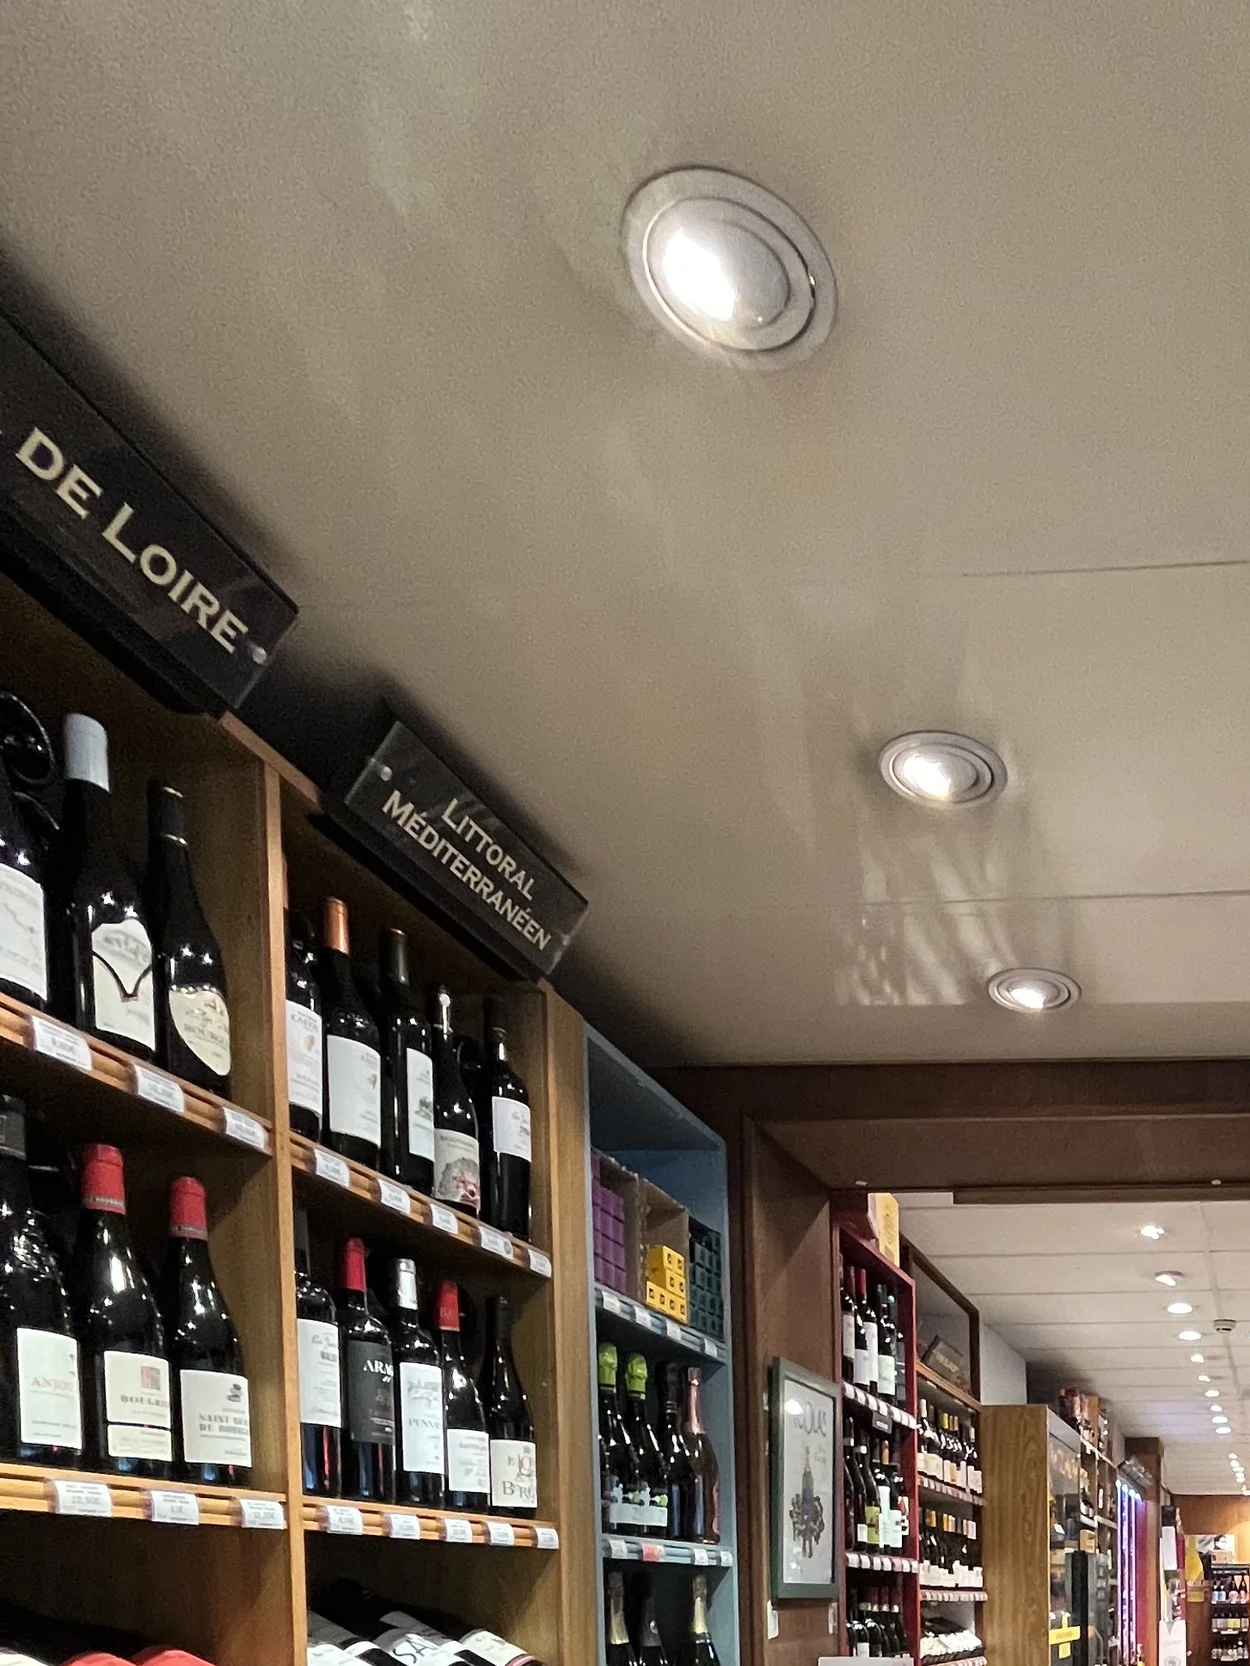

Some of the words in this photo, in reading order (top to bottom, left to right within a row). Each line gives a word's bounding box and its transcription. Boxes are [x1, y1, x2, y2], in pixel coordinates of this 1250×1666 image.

[16, 427, 103, 518] DE
[102, 501, 249, 653] LOIRE
[383, 789, 552, 952] MÉDITERRANÉEN
[441, 796, 535, 901] LITTORAL
